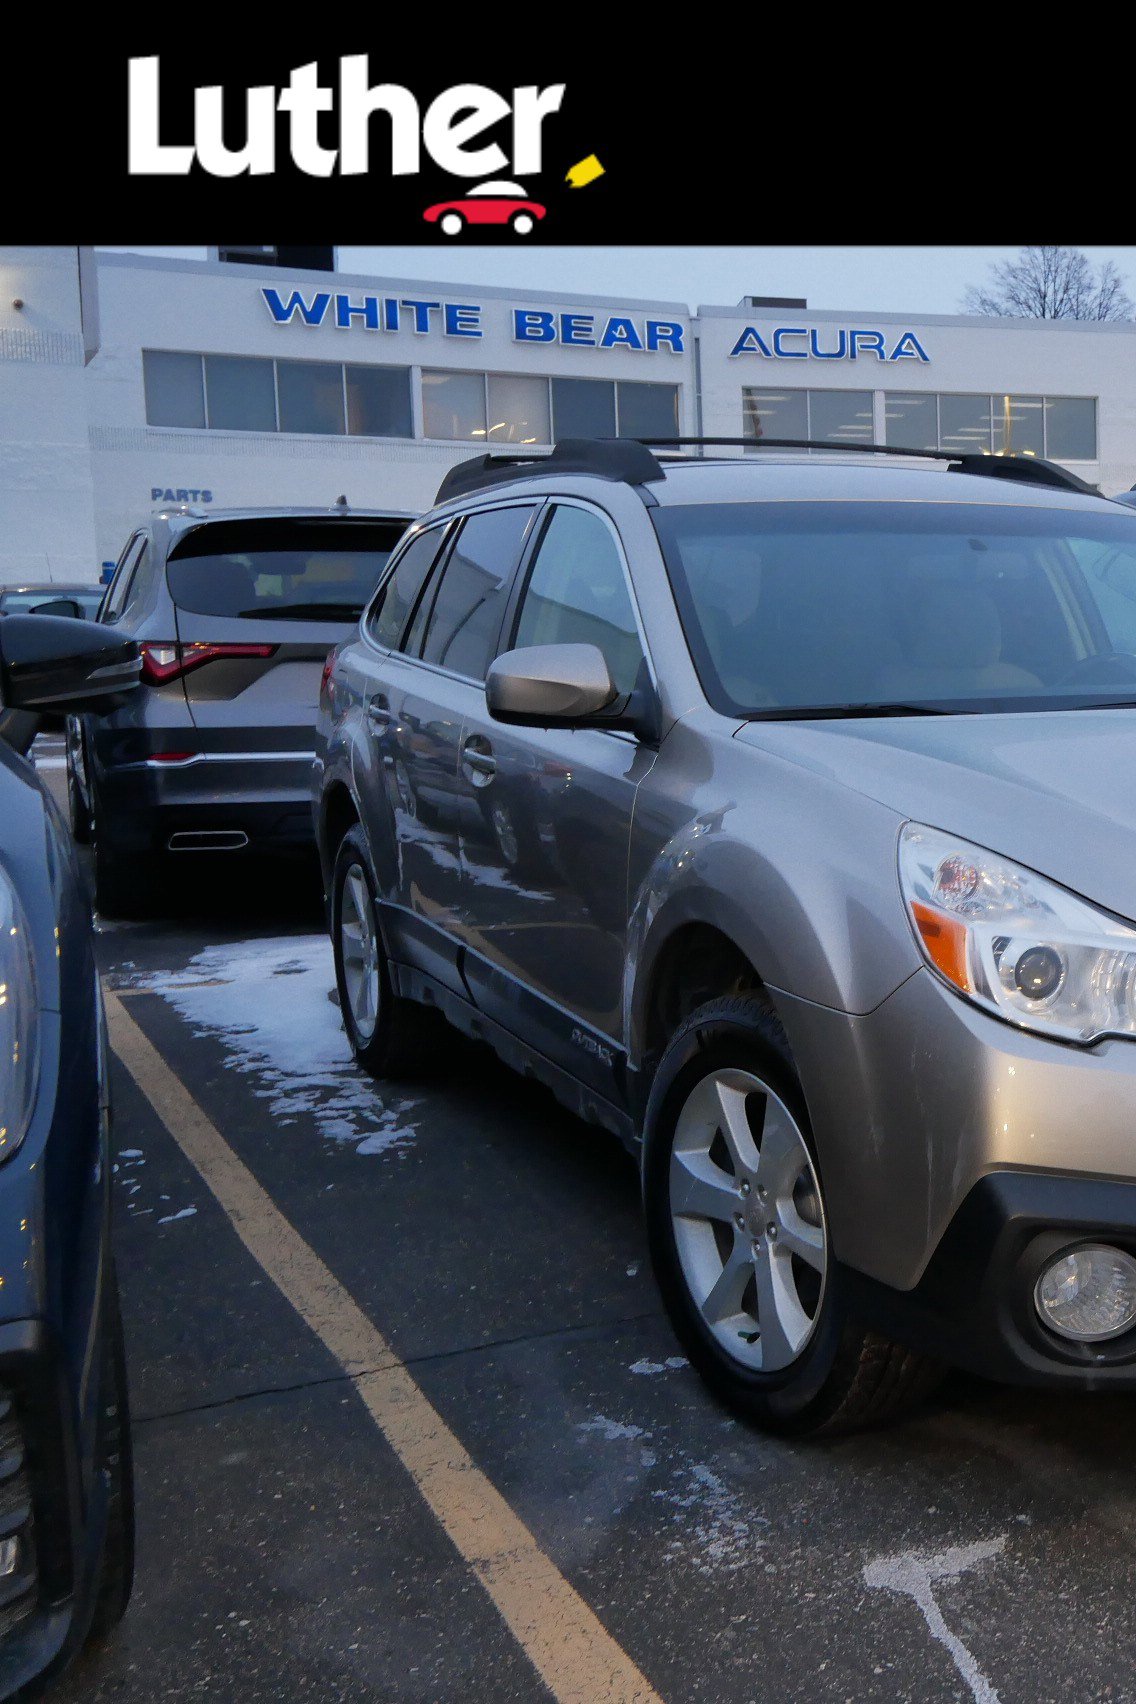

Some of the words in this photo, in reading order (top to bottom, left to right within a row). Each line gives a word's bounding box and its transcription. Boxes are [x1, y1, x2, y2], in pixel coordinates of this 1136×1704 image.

[260, 287, 484, 339] WHITE
[512, 307, 685, 355] BEAR
[728, 326, 931, 363] ACURA
[150, 487, 213, 504] PARTS
